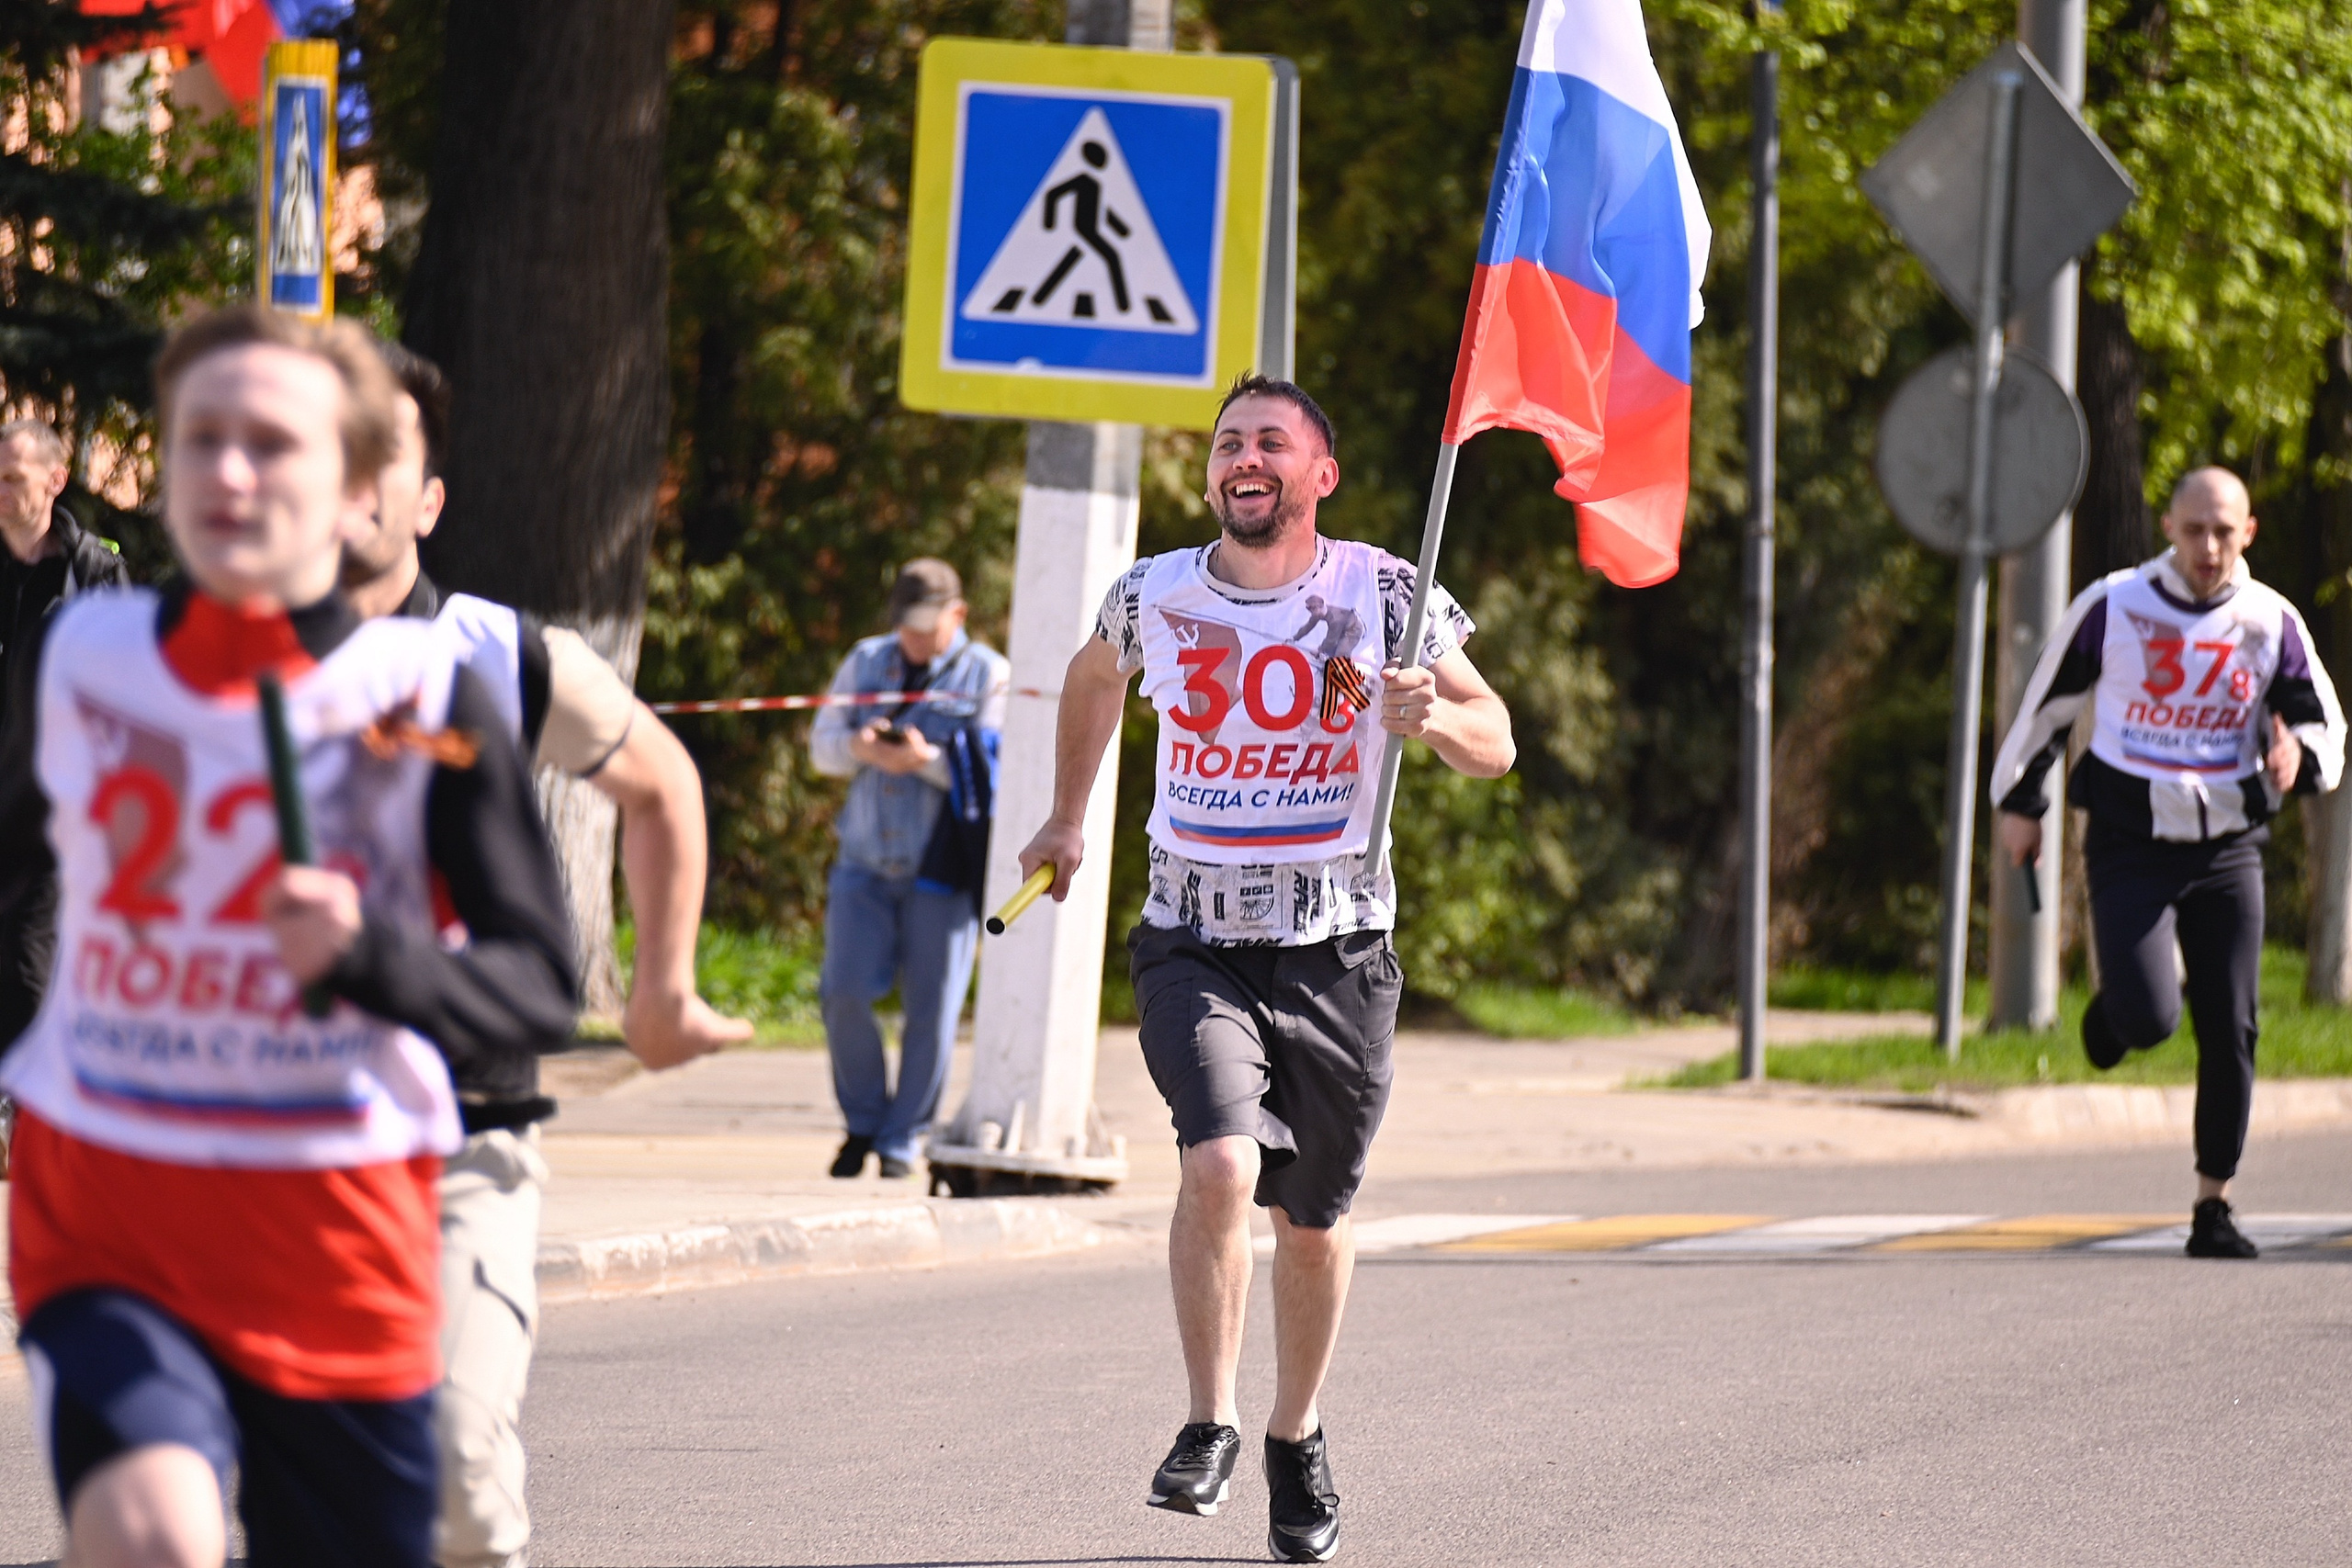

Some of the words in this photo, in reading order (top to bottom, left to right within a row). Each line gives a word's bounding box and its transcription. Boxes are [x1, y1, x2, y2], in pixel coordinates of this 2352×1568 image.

[1169, 739, 1360, 785] ПОБЕДА
[1168, 780, 1243, 811] ВСЕГДА
[1250, 789, 1271, 807] С
[1276, 782, 1355, 807] НАМИ!
[74, 932, 311, 1029] ПОБЕ
